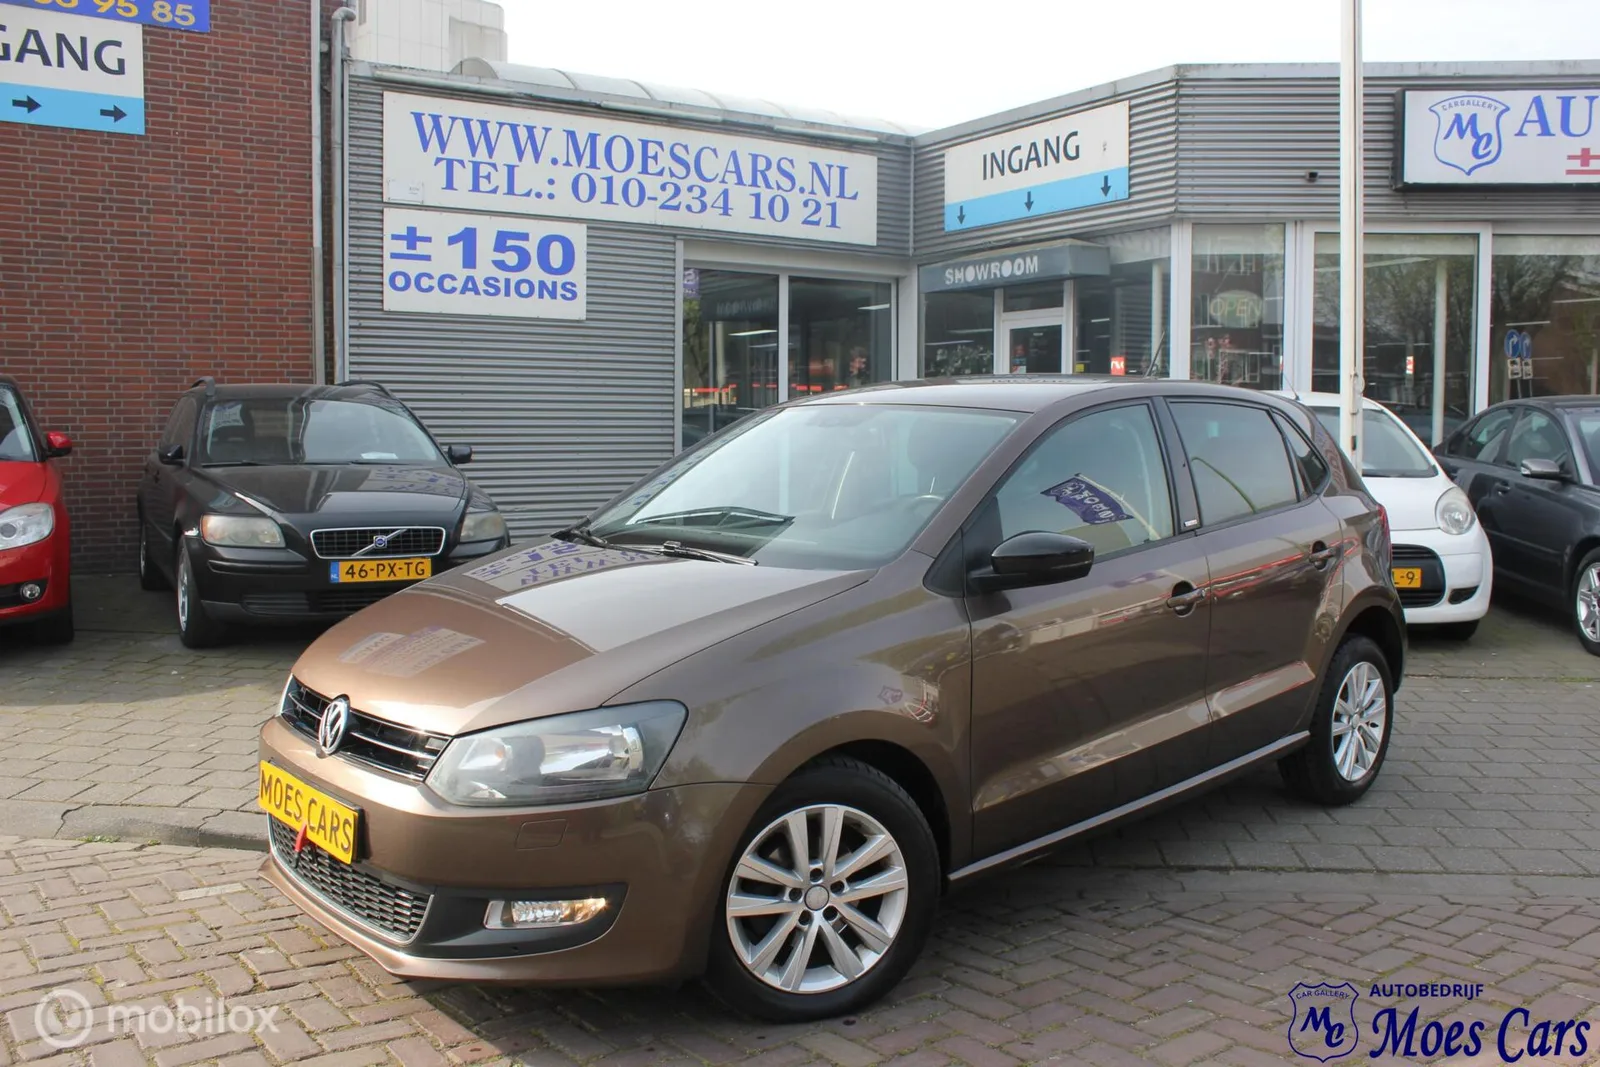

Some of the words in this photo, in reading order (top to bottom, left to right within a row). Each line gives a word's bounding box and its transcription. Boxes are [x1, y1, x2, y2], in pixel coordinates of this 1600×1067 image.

[151, 1, 196, 26] 85
[410, 111, 859, 200] WWW.MOESCARS.NL
[982, 131, 1080, 181] INGANG
[433, 157, 555, 200] TEL.:
[571, 172, 733, 217] 010-234
[749, 192, 790, 223] 10
[801, 198, 841, 229] 21
[447, 227, 576, 276] 150
[945, 256, 1039, 285] SHOWROOM
[388, 271, 578, 301] OCCASIONS
[345, 561, 425, 579] 46-PX-TG
[260, 769, 304, 823] MOES
[306, 797, 353, 855] CARS
